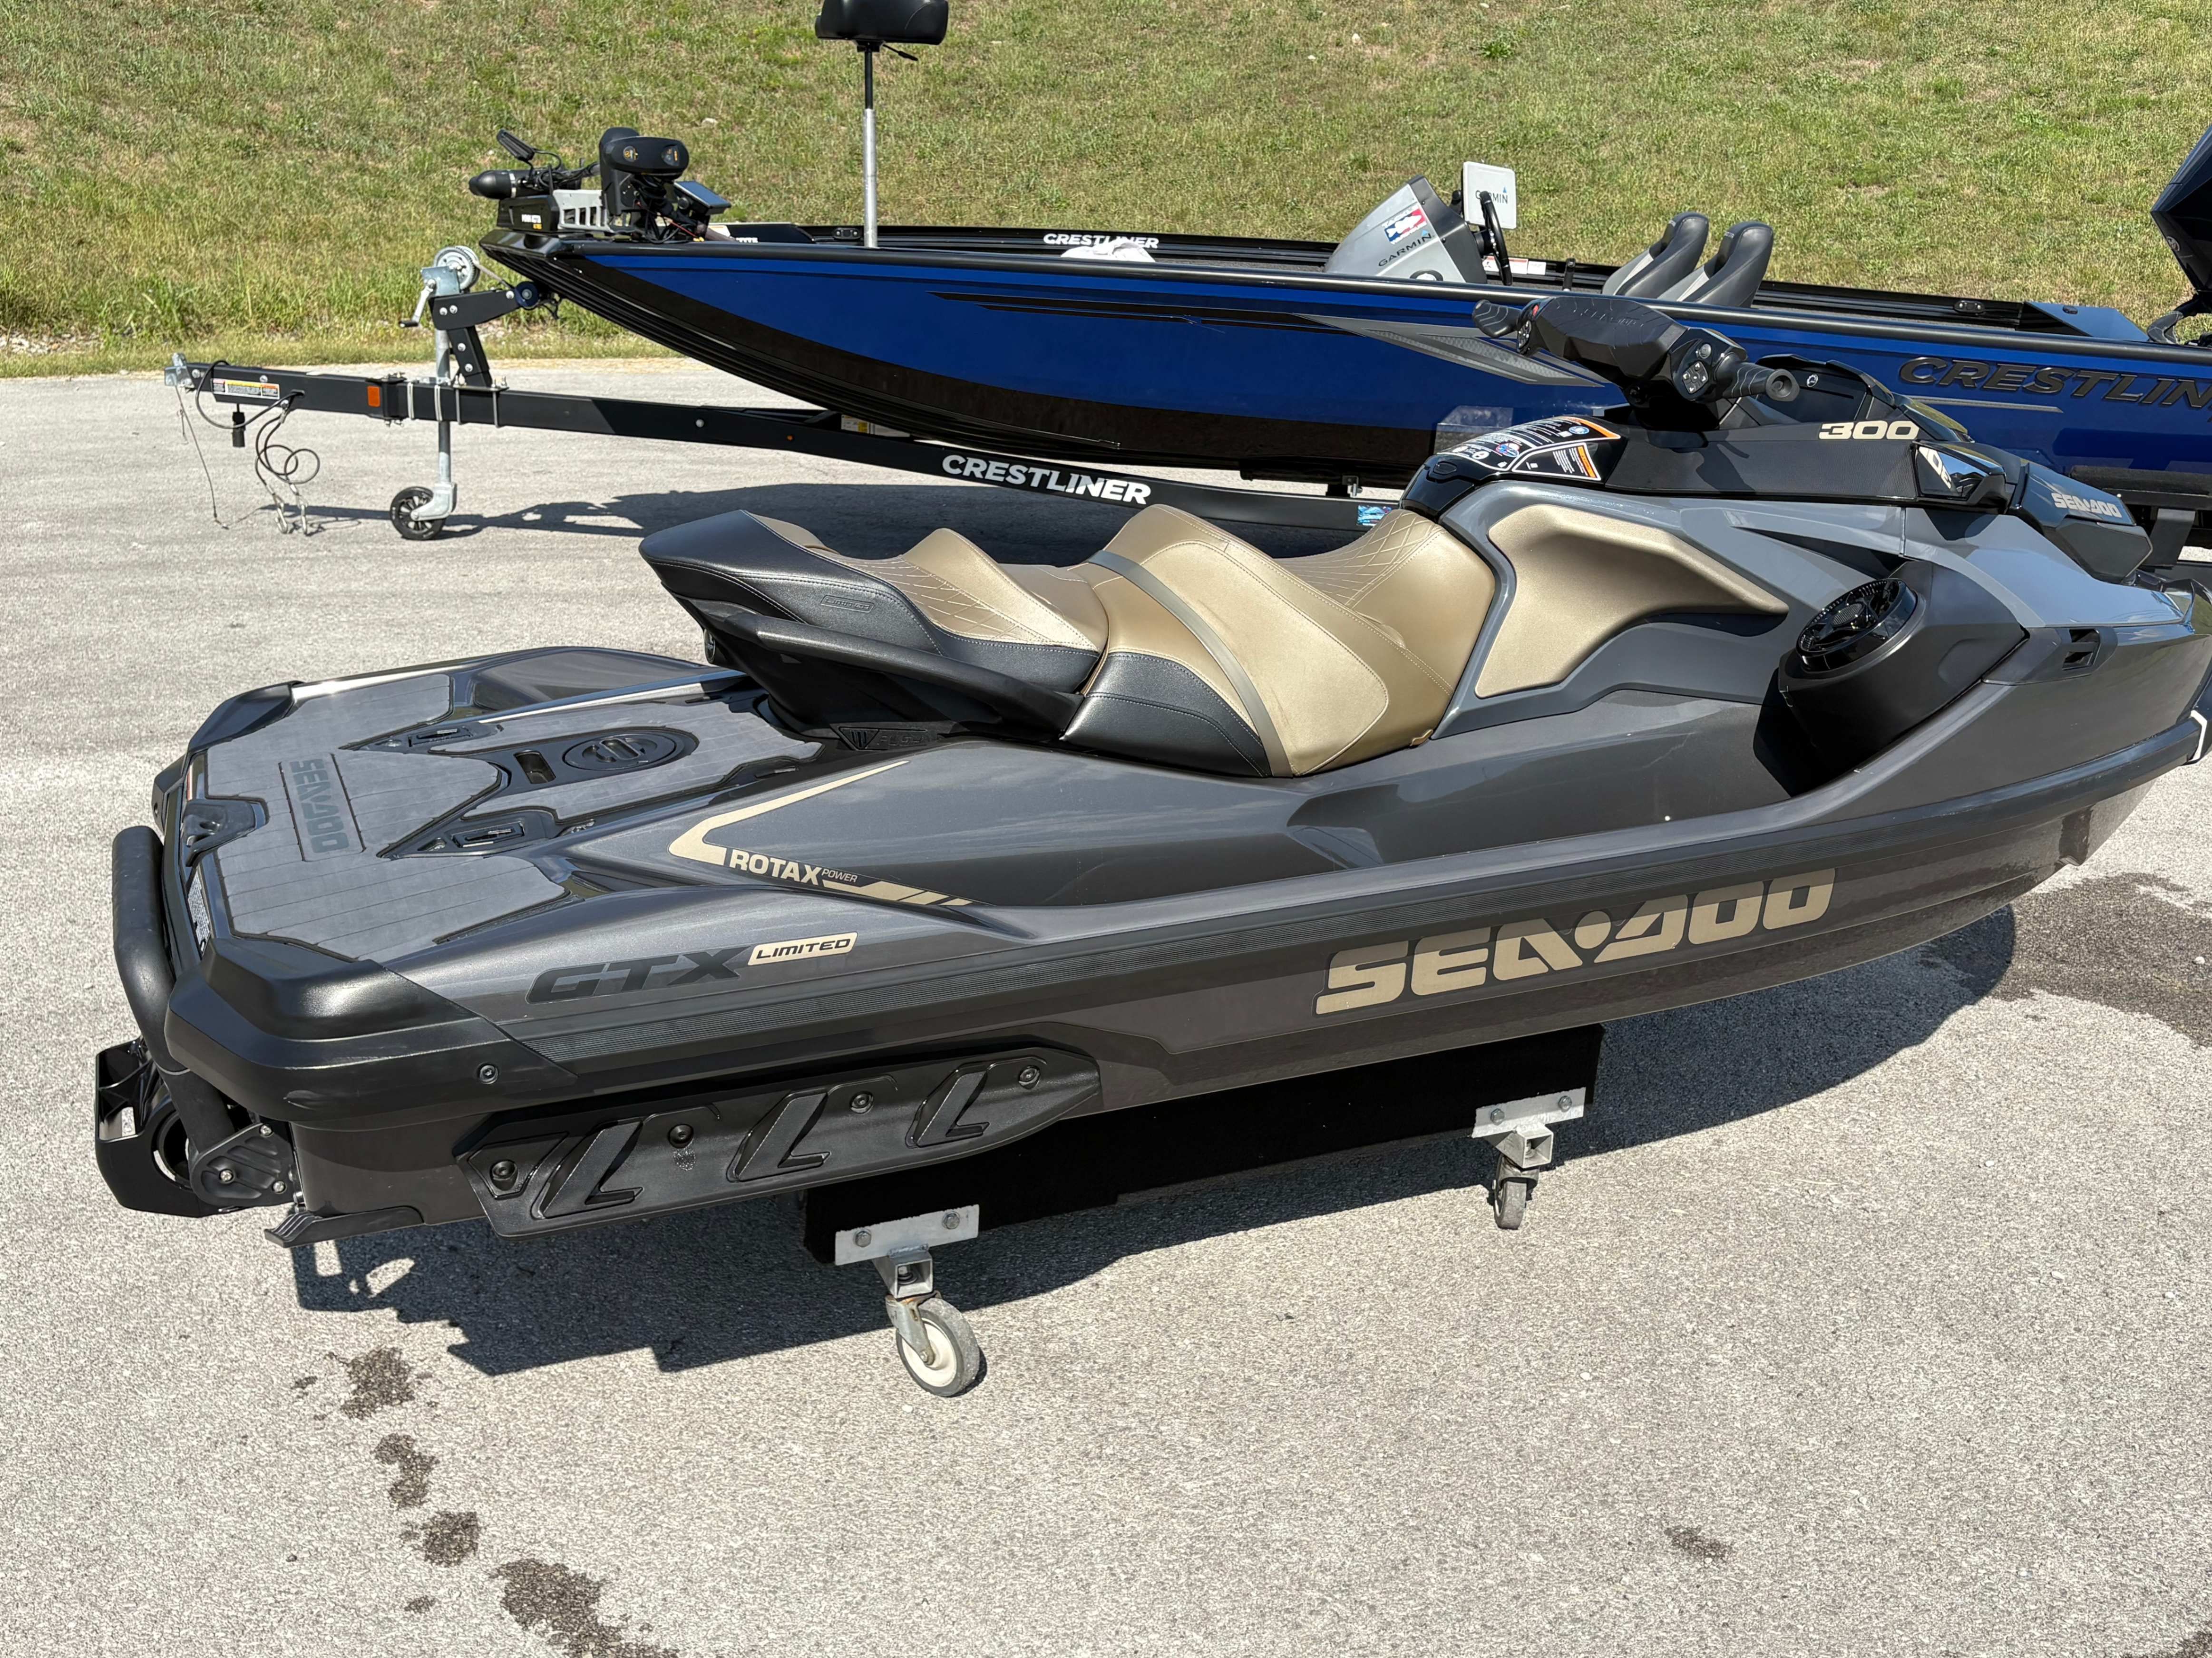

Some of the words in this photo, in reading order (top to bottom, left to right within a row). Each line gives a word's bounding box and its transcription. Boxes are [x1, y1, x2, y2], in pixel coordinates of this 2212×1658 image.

[1475, 190, 1508, 204] GMIN
[1043, 233, 1160, 248] CRESTER
[1378, 233, 1432, 266] GARMIN
[1819, 420, 1919, 440] 300
[942, 455, 1151, 504] CRESTLINER
[730, 849, 821, 885] ROTAX
[820, 868, 858, 883] POWER
[526, 946, 751, 1004] GTX
[756, 938, 851, 960] LIMITED
